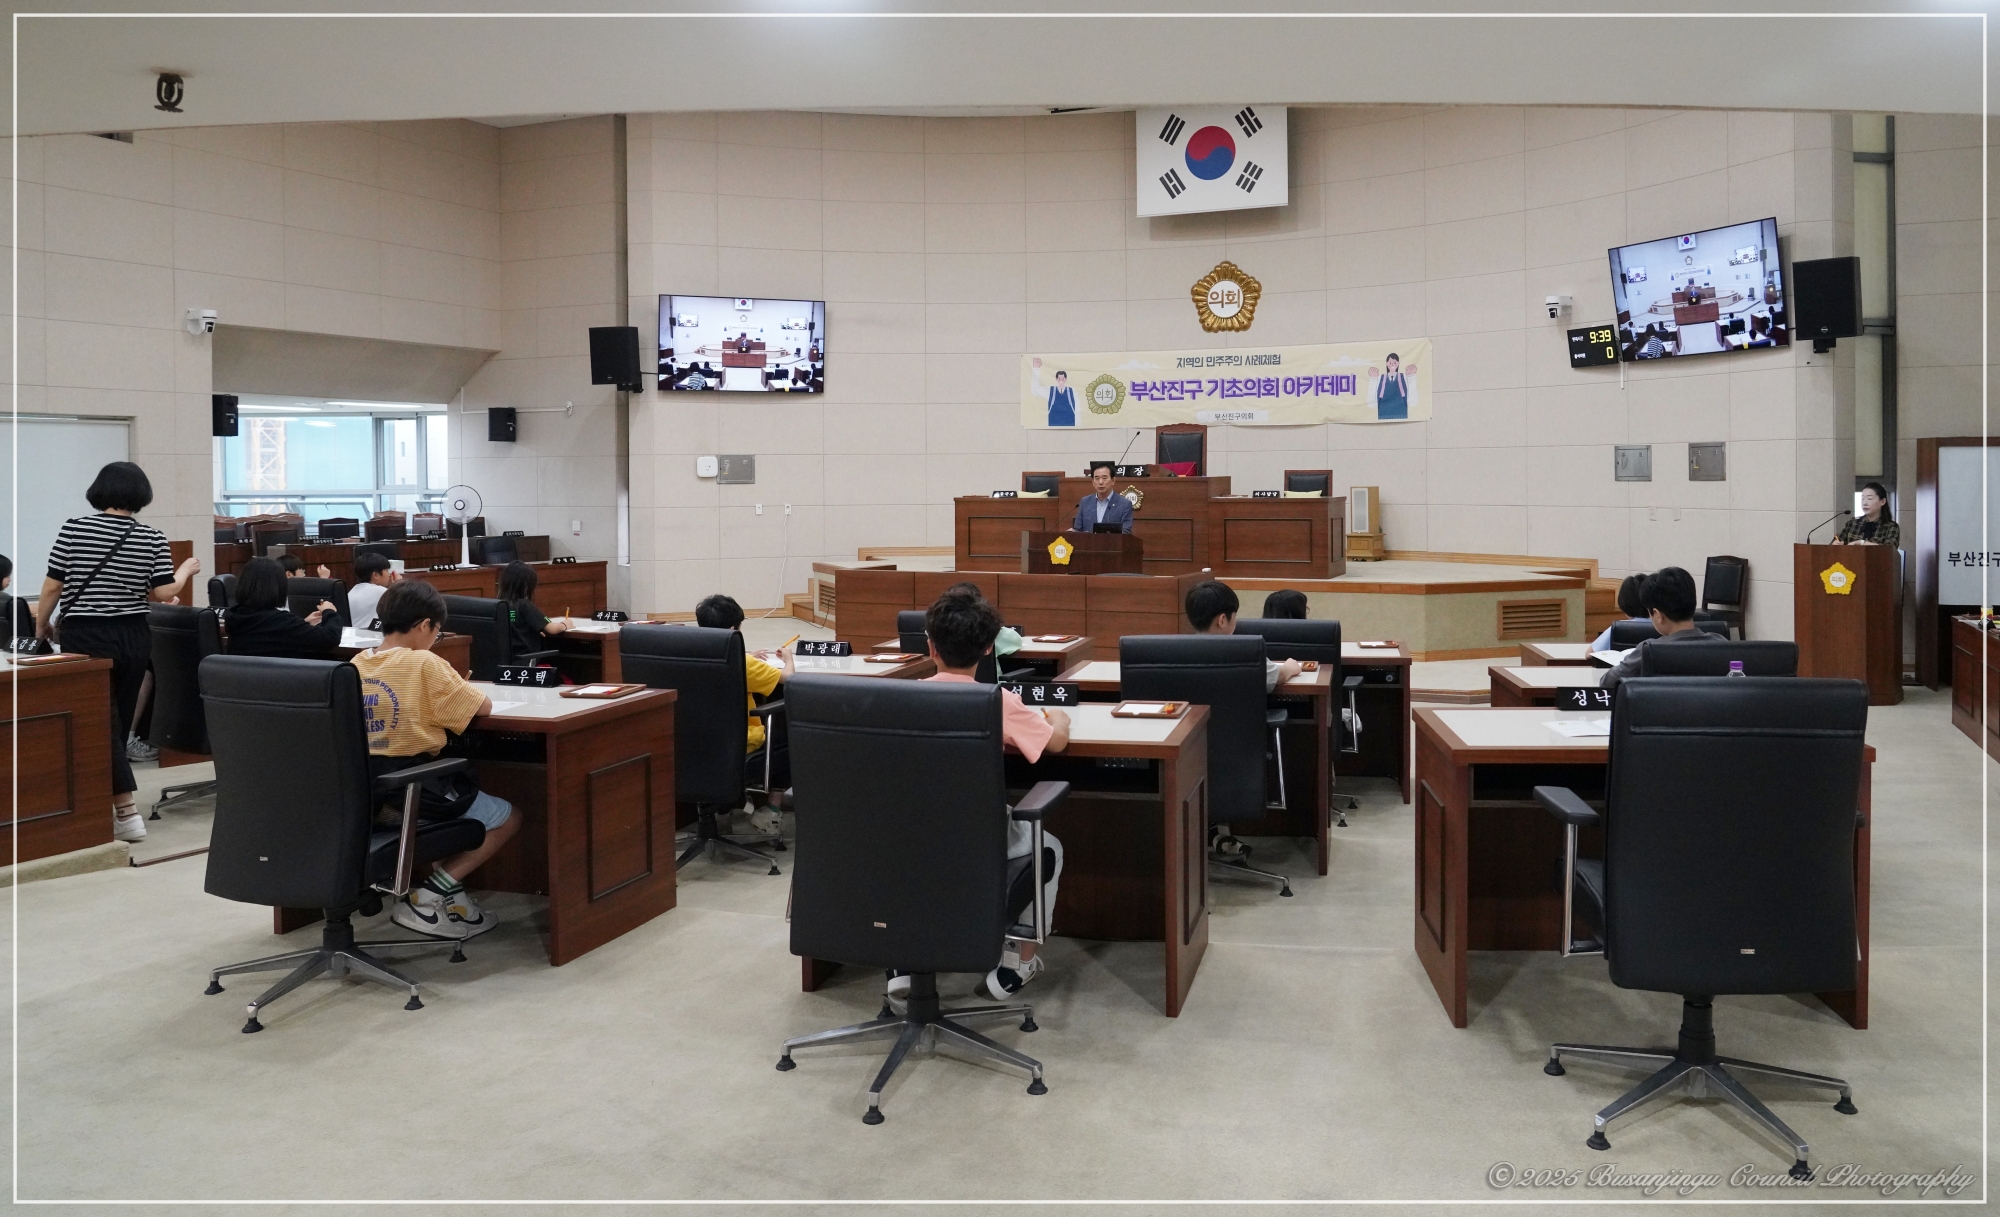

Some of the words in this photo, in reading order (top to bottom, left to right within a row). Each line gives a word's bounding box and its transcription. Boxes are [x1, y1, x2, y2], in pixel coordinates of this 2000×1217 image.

[1208, 288, 1241, 309] 의회
[1589, 329, 1612, 344] 9:39
[1606, 346, 1614, 359] 0
[1176, 356, 1204, 368] 지역의
[1206, 355, 1243, 367] 민주주의
[1244, 354, 1281, 366] 사례체험
[1095, 388, 1114, 401] 의회
[1128, 379, 1204, 402] 부산진구
[1205, 377, 1280, 400] 기초의회
[1282, 373, 1357, 398] 아카데미
[1214, 412, 1254, 421] 부산진구의회
[804, 642, 841, 654] 박광래
[499, 669, 547, 685] 오우택
[1572, 689, 1611, 707] 성낙
